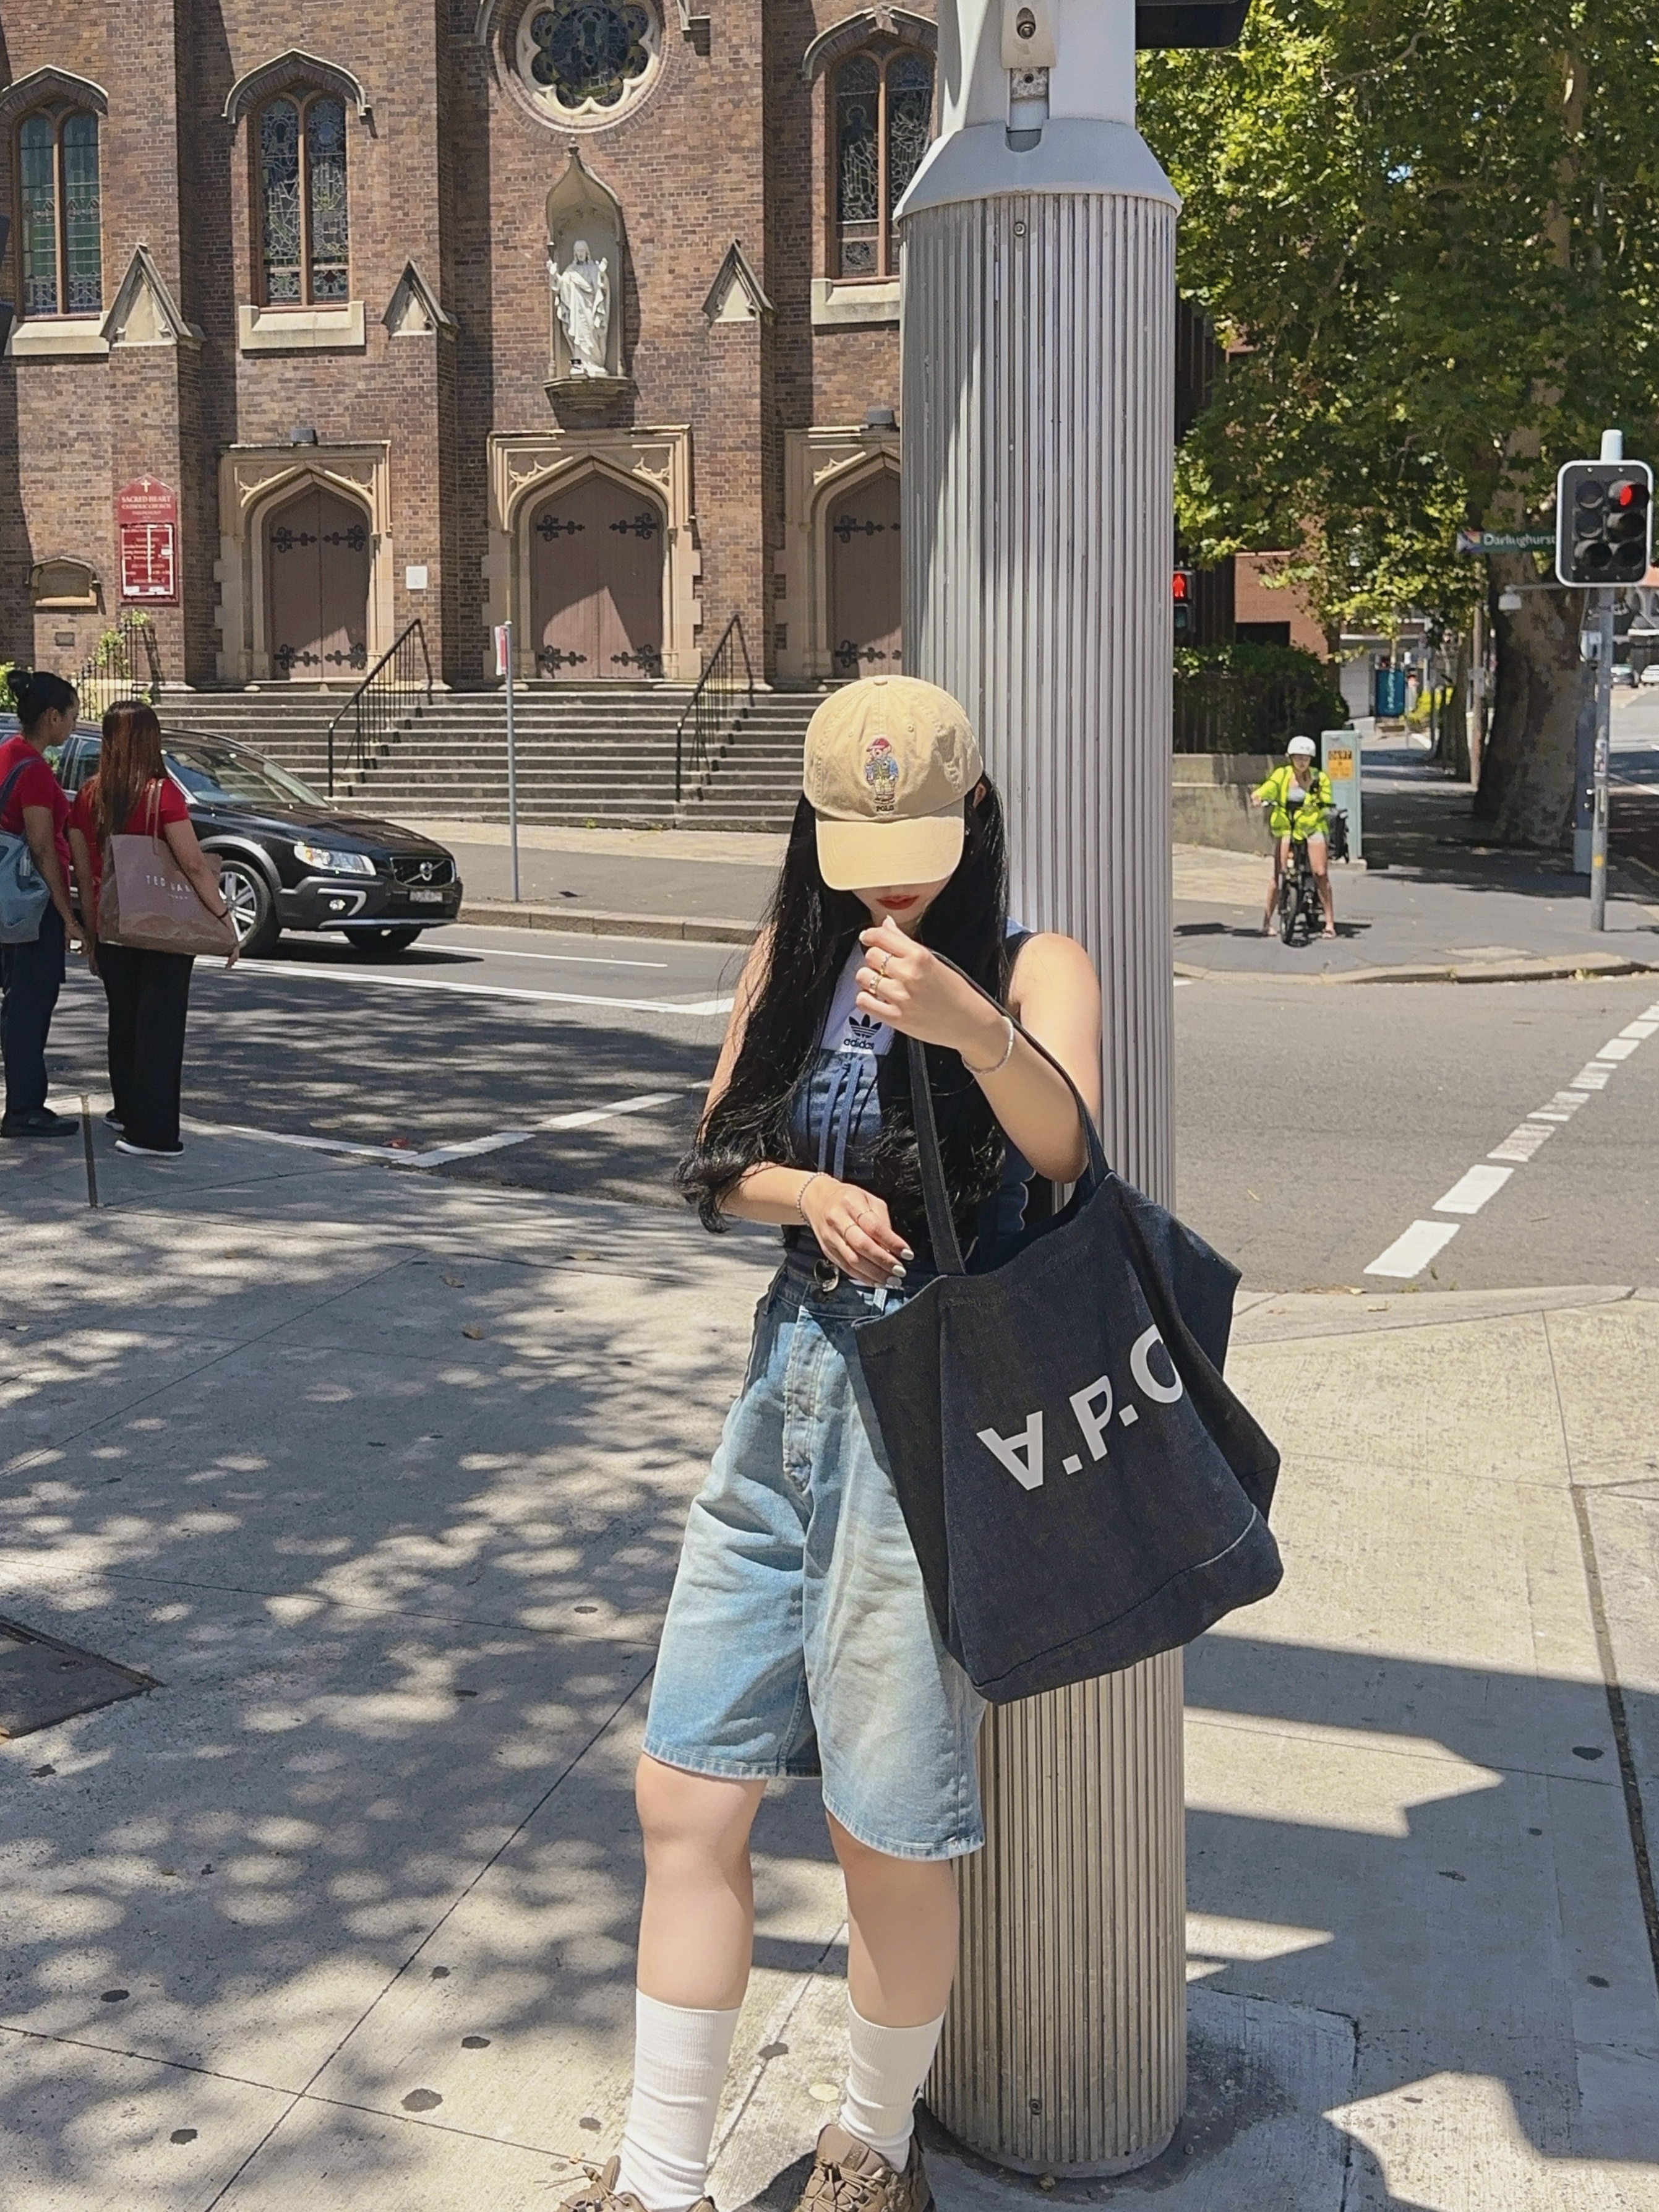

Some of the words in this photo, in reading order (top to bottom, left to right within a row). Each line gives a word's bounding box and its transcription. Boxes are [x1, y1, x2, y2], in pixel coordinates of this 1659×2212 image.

[1484, 533, 1555, 548] Darlinghurst
[146, 875, 165, 887] TED
[844, 1038, 874, 1049] adidas
